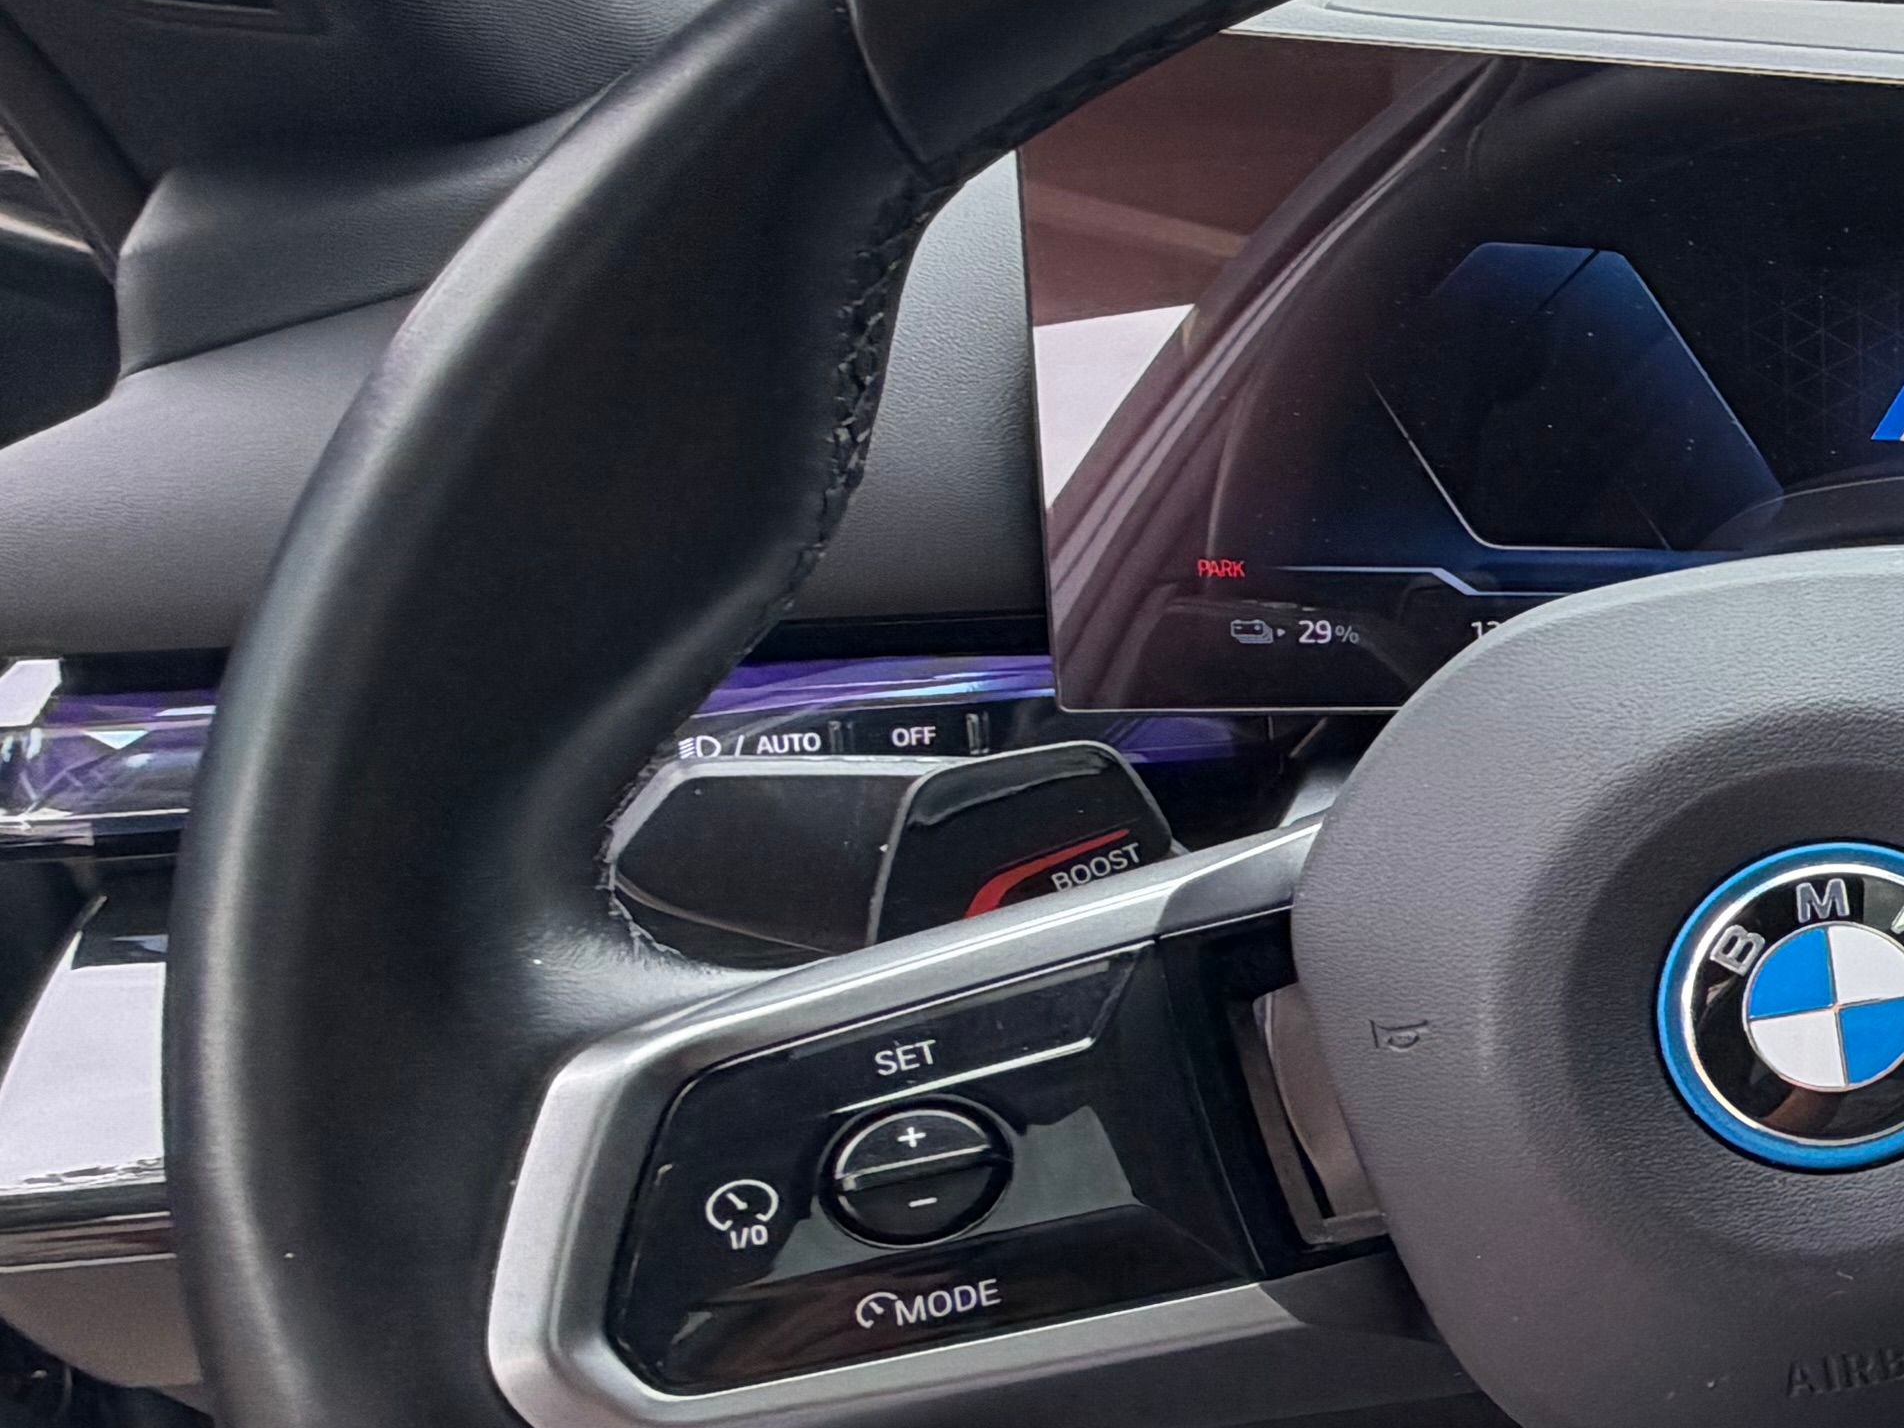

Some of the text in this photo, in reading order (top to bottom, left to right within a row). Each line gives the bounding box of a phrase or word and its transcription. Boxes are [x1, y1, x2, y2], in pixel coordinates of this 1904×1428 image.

[1196, 559, 1246, 579] PARK
[756, 731, 822, 755] AUTO
[891, 725, 936, 749] OFF
[1050, 842, 1141, 893] BOOST
[875, 1039, 936, 1077] SET
[894, 1277, 1002, 1327] MODE
